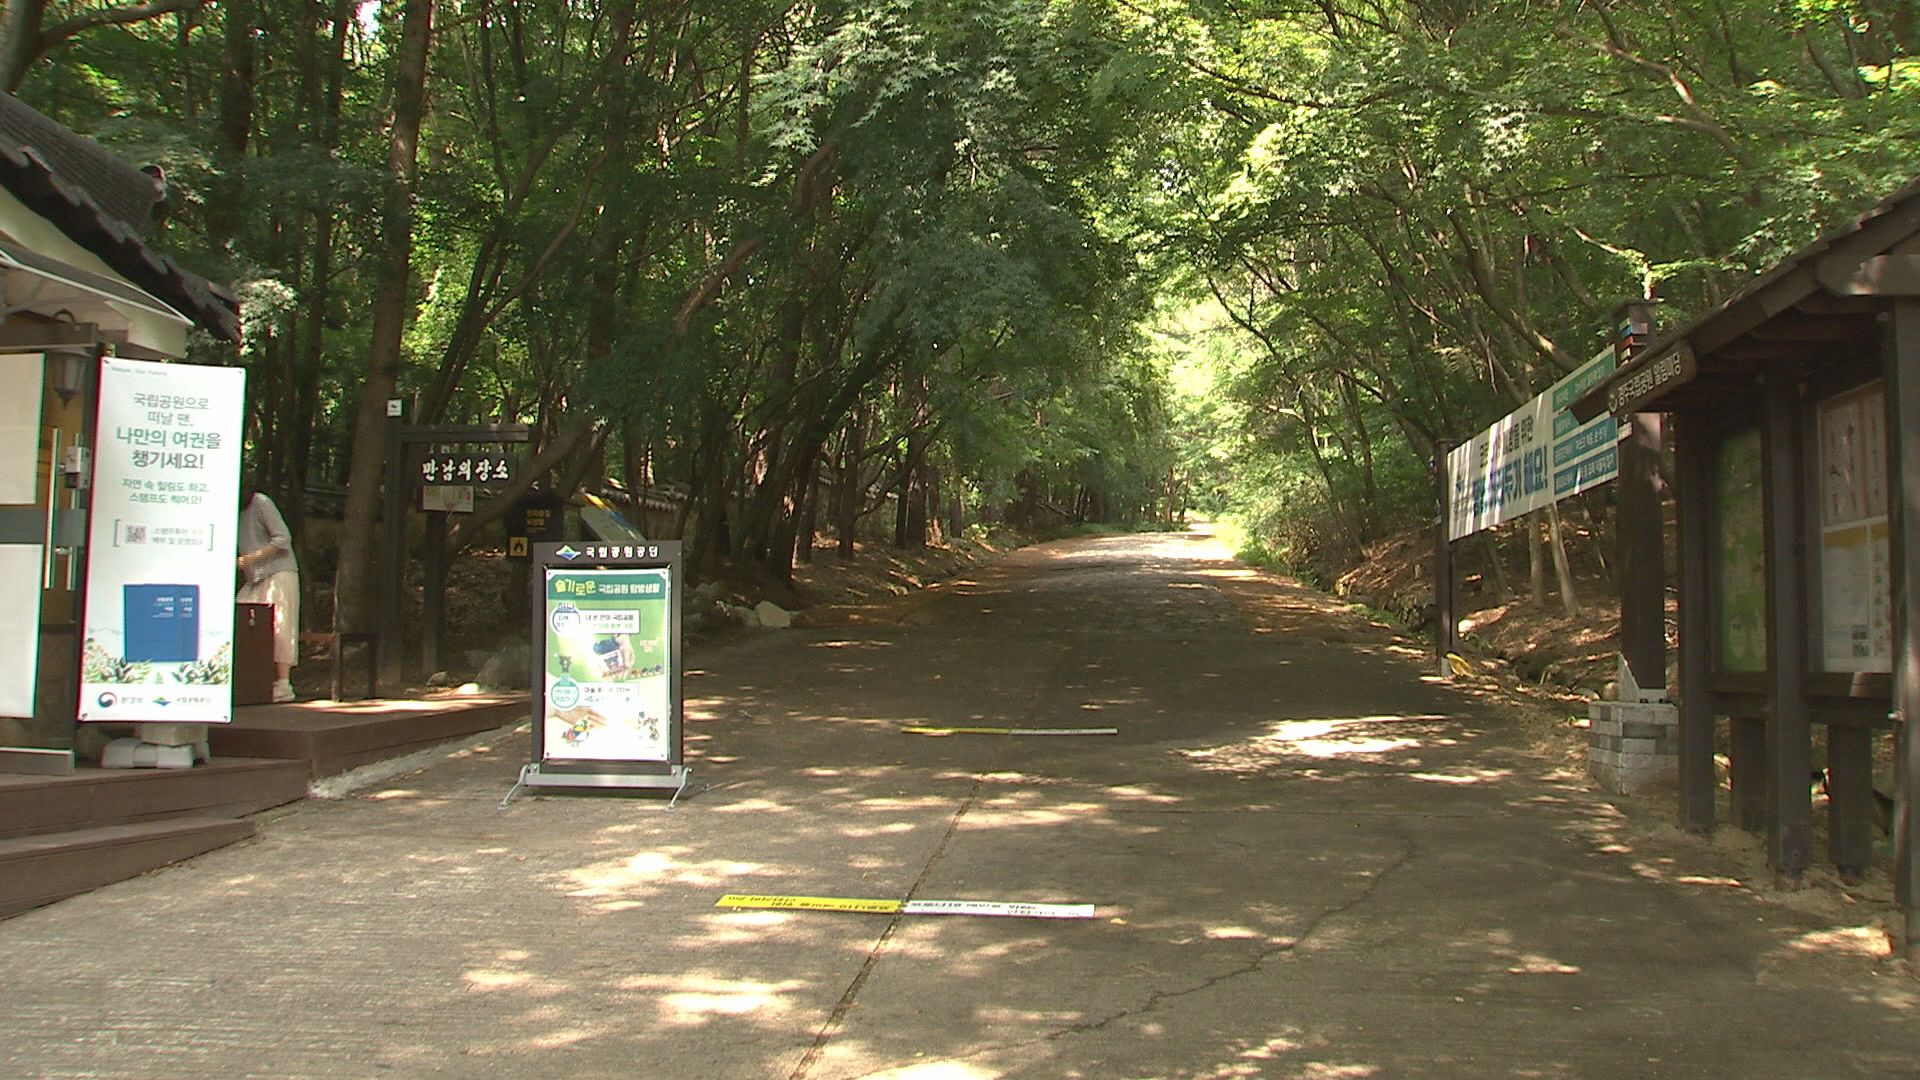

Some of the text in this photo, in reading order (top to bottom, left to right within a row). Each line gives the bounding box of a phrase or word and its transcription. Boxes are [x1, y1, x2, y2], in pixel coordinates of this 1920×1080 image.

[1653, 352, 1681, 385] 알림마당
[133, 392, 211, 410] 국립공원으로
[147, 411, 173, 426] 떠날
[116, 426, 222, 449] 나만의 여권을
[132, 450, 204, 469] 챙기세요!
[121, 478, 142, 490] 자연
[144, 480, 154, 490] 속
[157, 480, 186, 492] 힐링도
[129, 493, 202, 505] 스탬프도 찍어요!
[586, 545, 659, 558] 국립공원공단
[555, 579, 596, 596] 슬기로운
[598, 584, 629, 595] 국립공원
